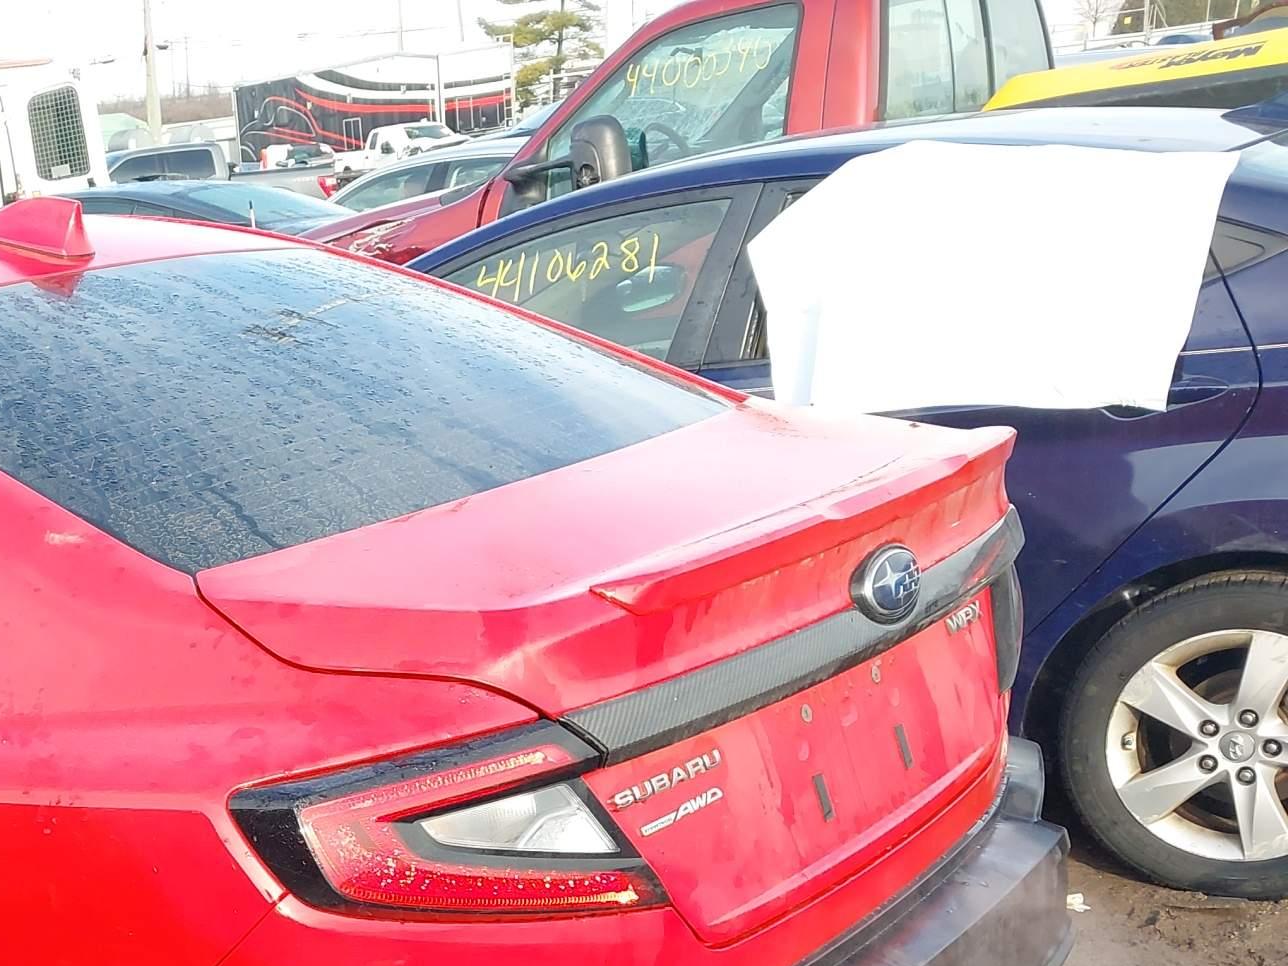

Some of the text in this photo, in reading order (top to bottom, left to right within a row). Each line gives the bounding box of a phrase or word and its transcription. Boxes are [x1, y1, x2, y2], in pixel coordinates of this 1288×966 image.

[476, 233, 659, 302] 44106281
[944, 600, 983, 634] WRX
[613, 748, 721, 809] SUBARU
[675, 787, 724, 821] AWD
